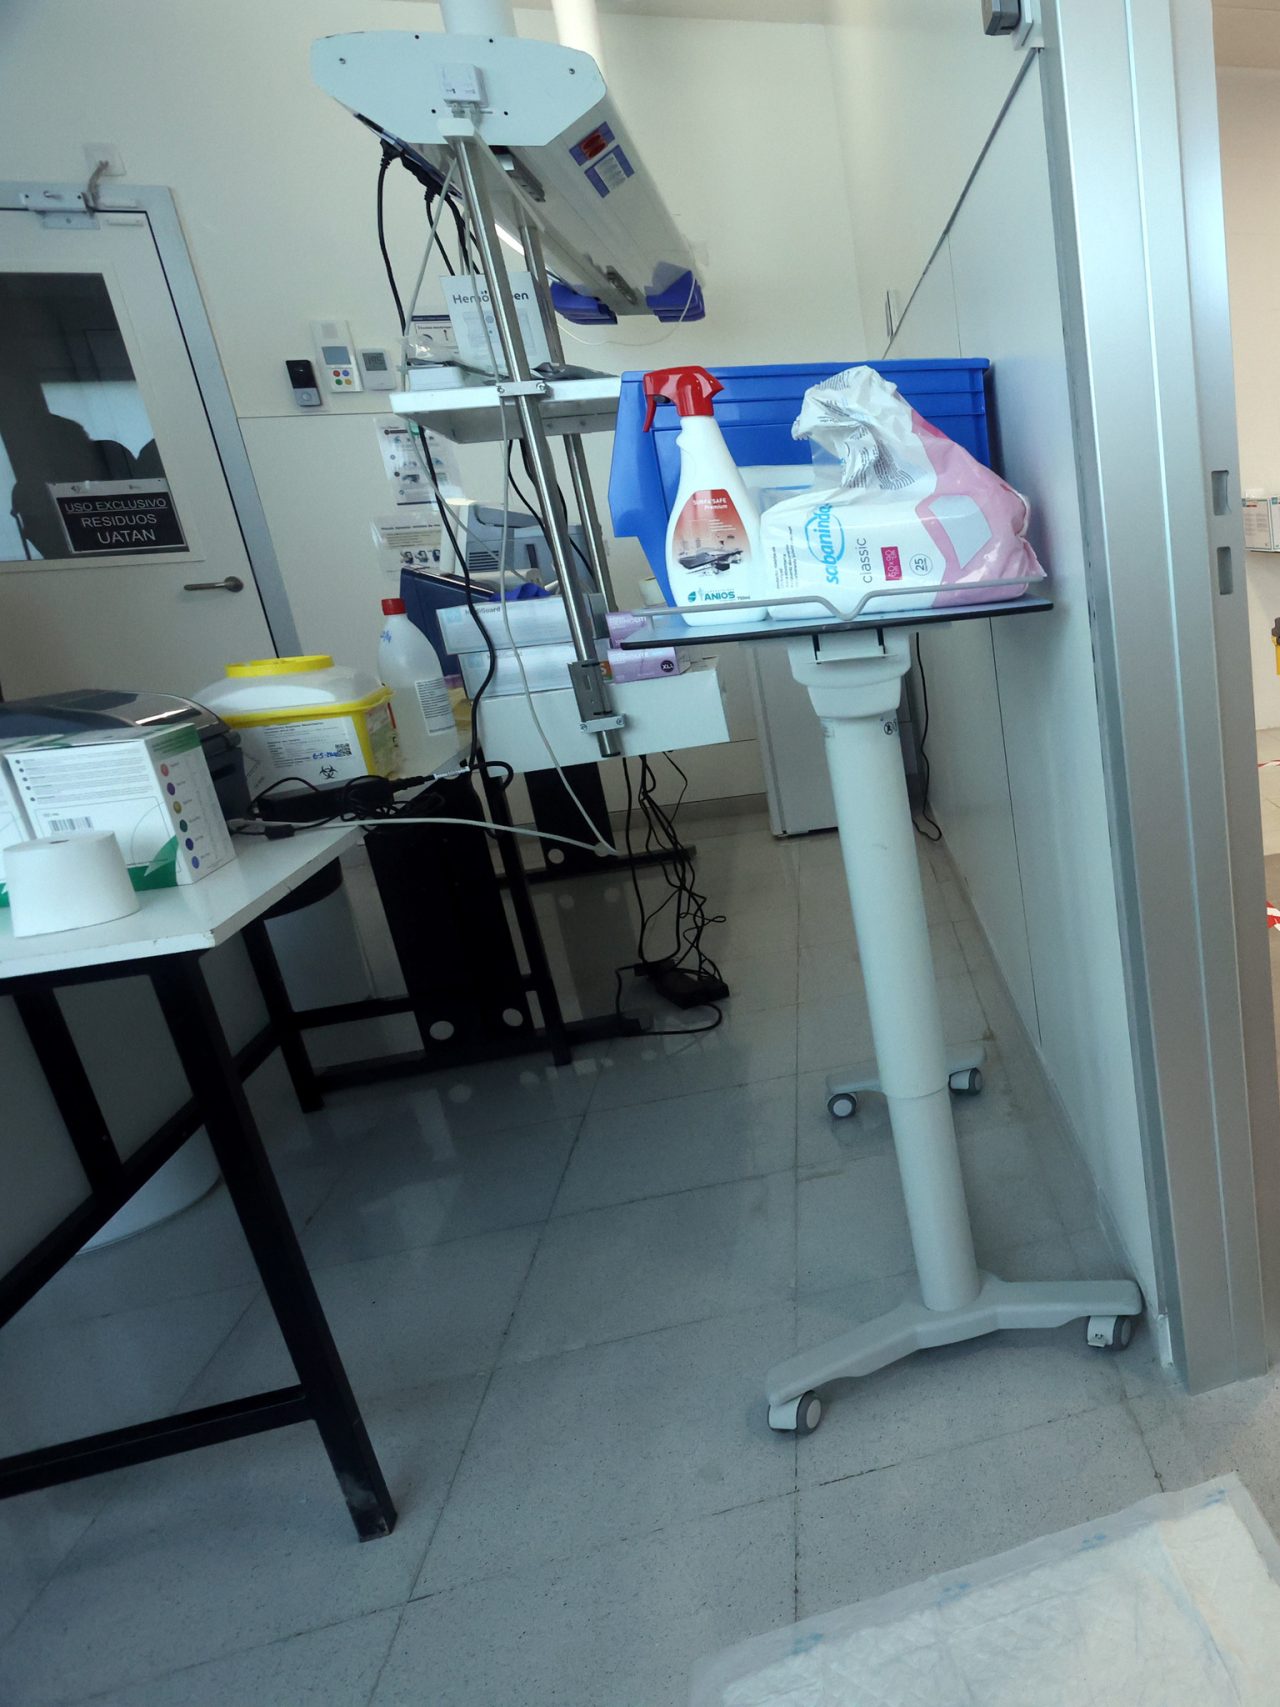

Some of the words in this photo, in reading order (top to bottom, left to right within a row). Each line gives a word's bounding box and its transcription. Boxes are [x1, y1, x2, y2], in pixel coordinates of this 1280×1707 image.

[65, 502, 93, 513] USO
[96, 498, 167, 511] EXCLUSIVO
[81, 513, 157, 527] RESIDUOS
[97, 529, 156, 544] UATAN
[813, 503, 839, 584] sabaninda
[855, 537, 873, 584] classic
[914, 558, 925, 571] 25
[704, 591, 736, 601] ANIOS
